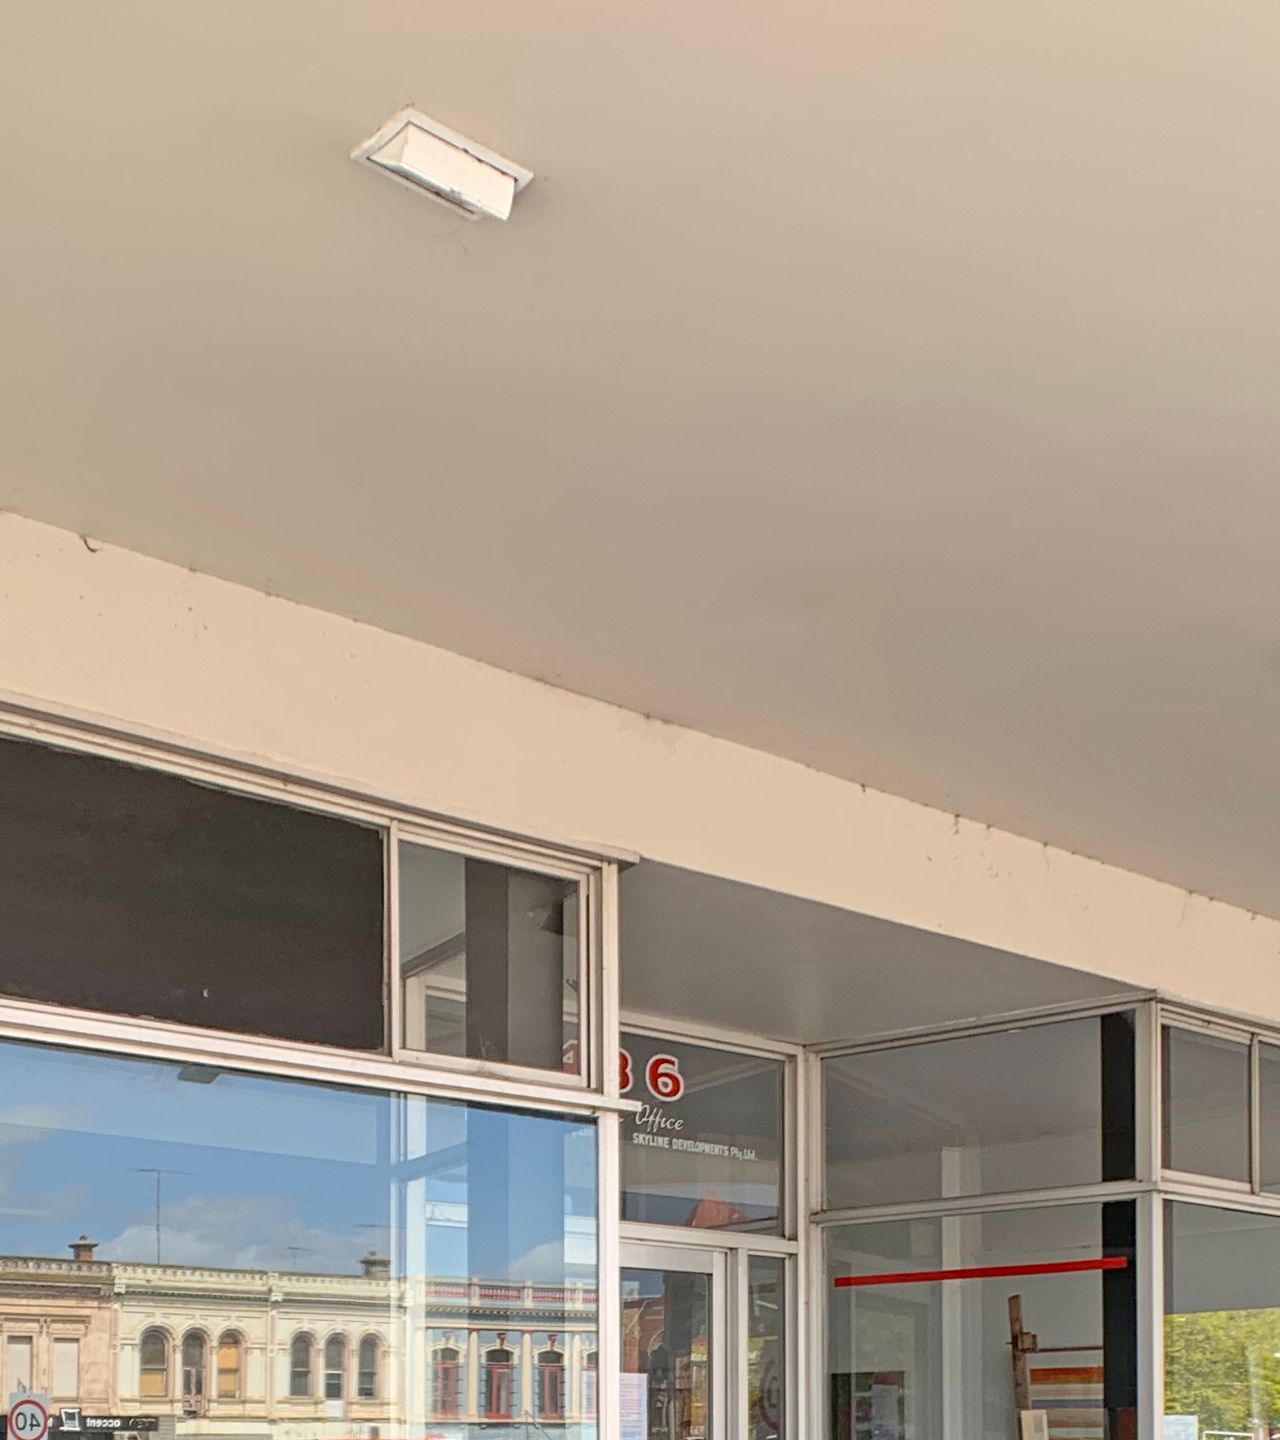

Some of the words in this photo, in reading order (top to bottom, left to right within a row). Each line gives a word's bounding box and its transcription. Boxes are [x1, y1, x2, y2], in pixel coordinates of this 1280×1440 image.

[635, 1104, 684, 1132] Office
[632, 1132, 670, 1148] SKYLINE
[672, 1138, 729, 1156] DEVELOPMENTS
